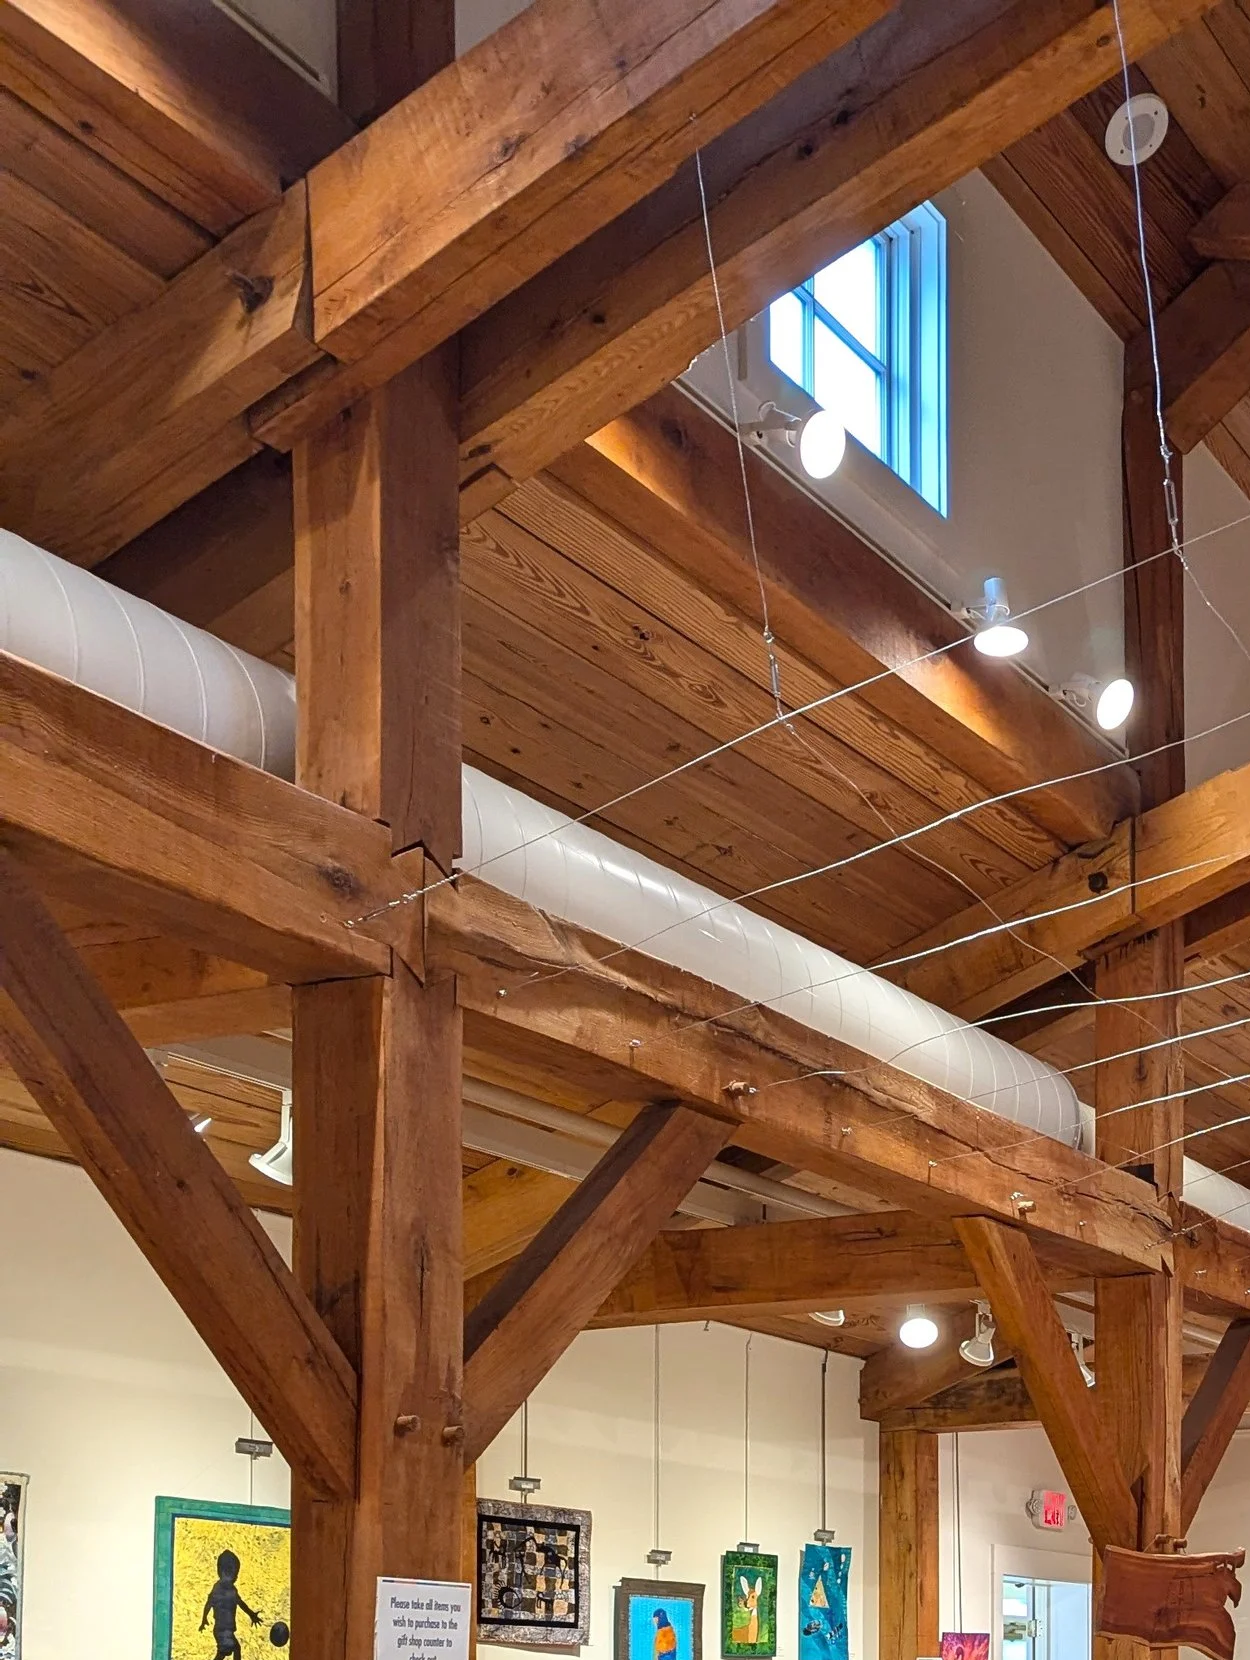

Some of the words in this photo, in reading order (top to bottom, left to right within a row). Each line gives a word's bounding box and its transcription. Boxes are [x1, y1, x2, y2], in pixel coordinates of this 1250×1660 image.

[390, 1597, 410, 1609] Please
[412, 1598, 424, 1610] take
[434, 1601, 449, 1611] items
[450, 1604, 461, 1614] you
[393, 1616, 406, 1627] wish
[408, 1619, 414, 1627] to
[415, 1617, 440, 1630] purchase
[441, 1620, 447, 1629] to
[448, 1618, 458, 1630] the
[397, 1634, 407, 1648] gift
[409, 1635, 422, 1649] shop
[424, 1638, 445, 1647] counter
[446, 1638, 452, 1647] to
